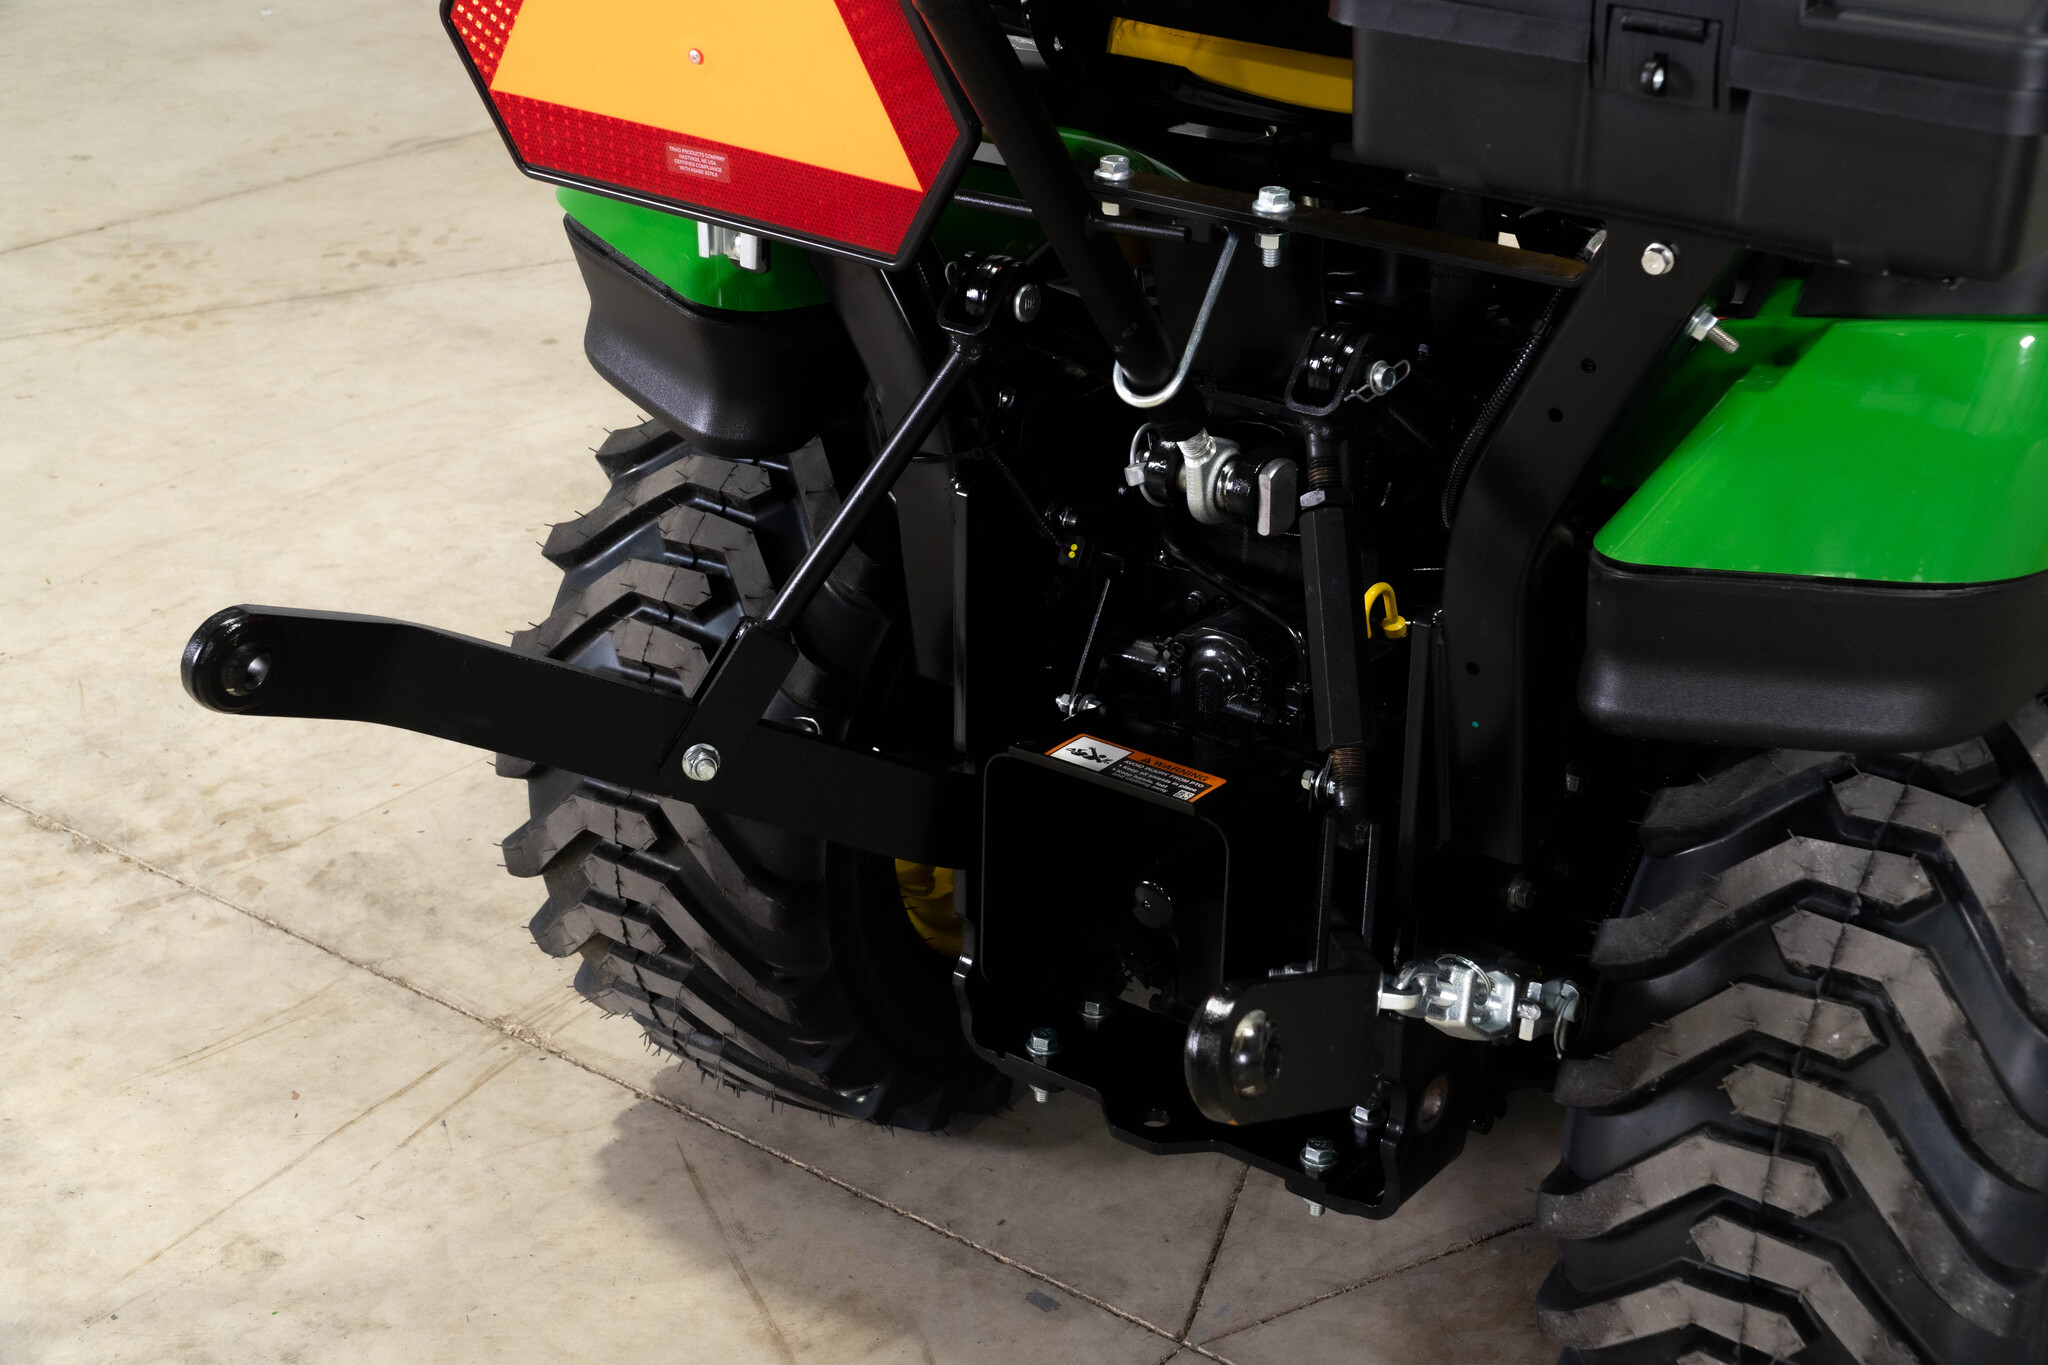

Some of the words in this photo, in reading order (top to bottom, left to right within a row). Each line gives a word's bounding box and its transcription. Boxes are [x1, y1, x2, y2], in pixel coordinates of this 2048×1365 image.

[681, 148, 705, 158] PRODUCTS
[705, 153, 725, 162] COMPANY
[695, 163, 722, 173] COMPLIANCE
[1116, 769, 1133, 777] Keep
[1122, 765, 1139, 774] Keep
[1148, 774, 1171, 784] shields
[1178, 784, 1197, 792] place
[1123, 760, 1144, 769] AVOID
[1144, 766, 1170, 777] INJURY
[1169, 773, 1190, 783] FROM
[1189, 780, 1204, 788] PTO
[1153, 760, 1209, 782] WARNING
